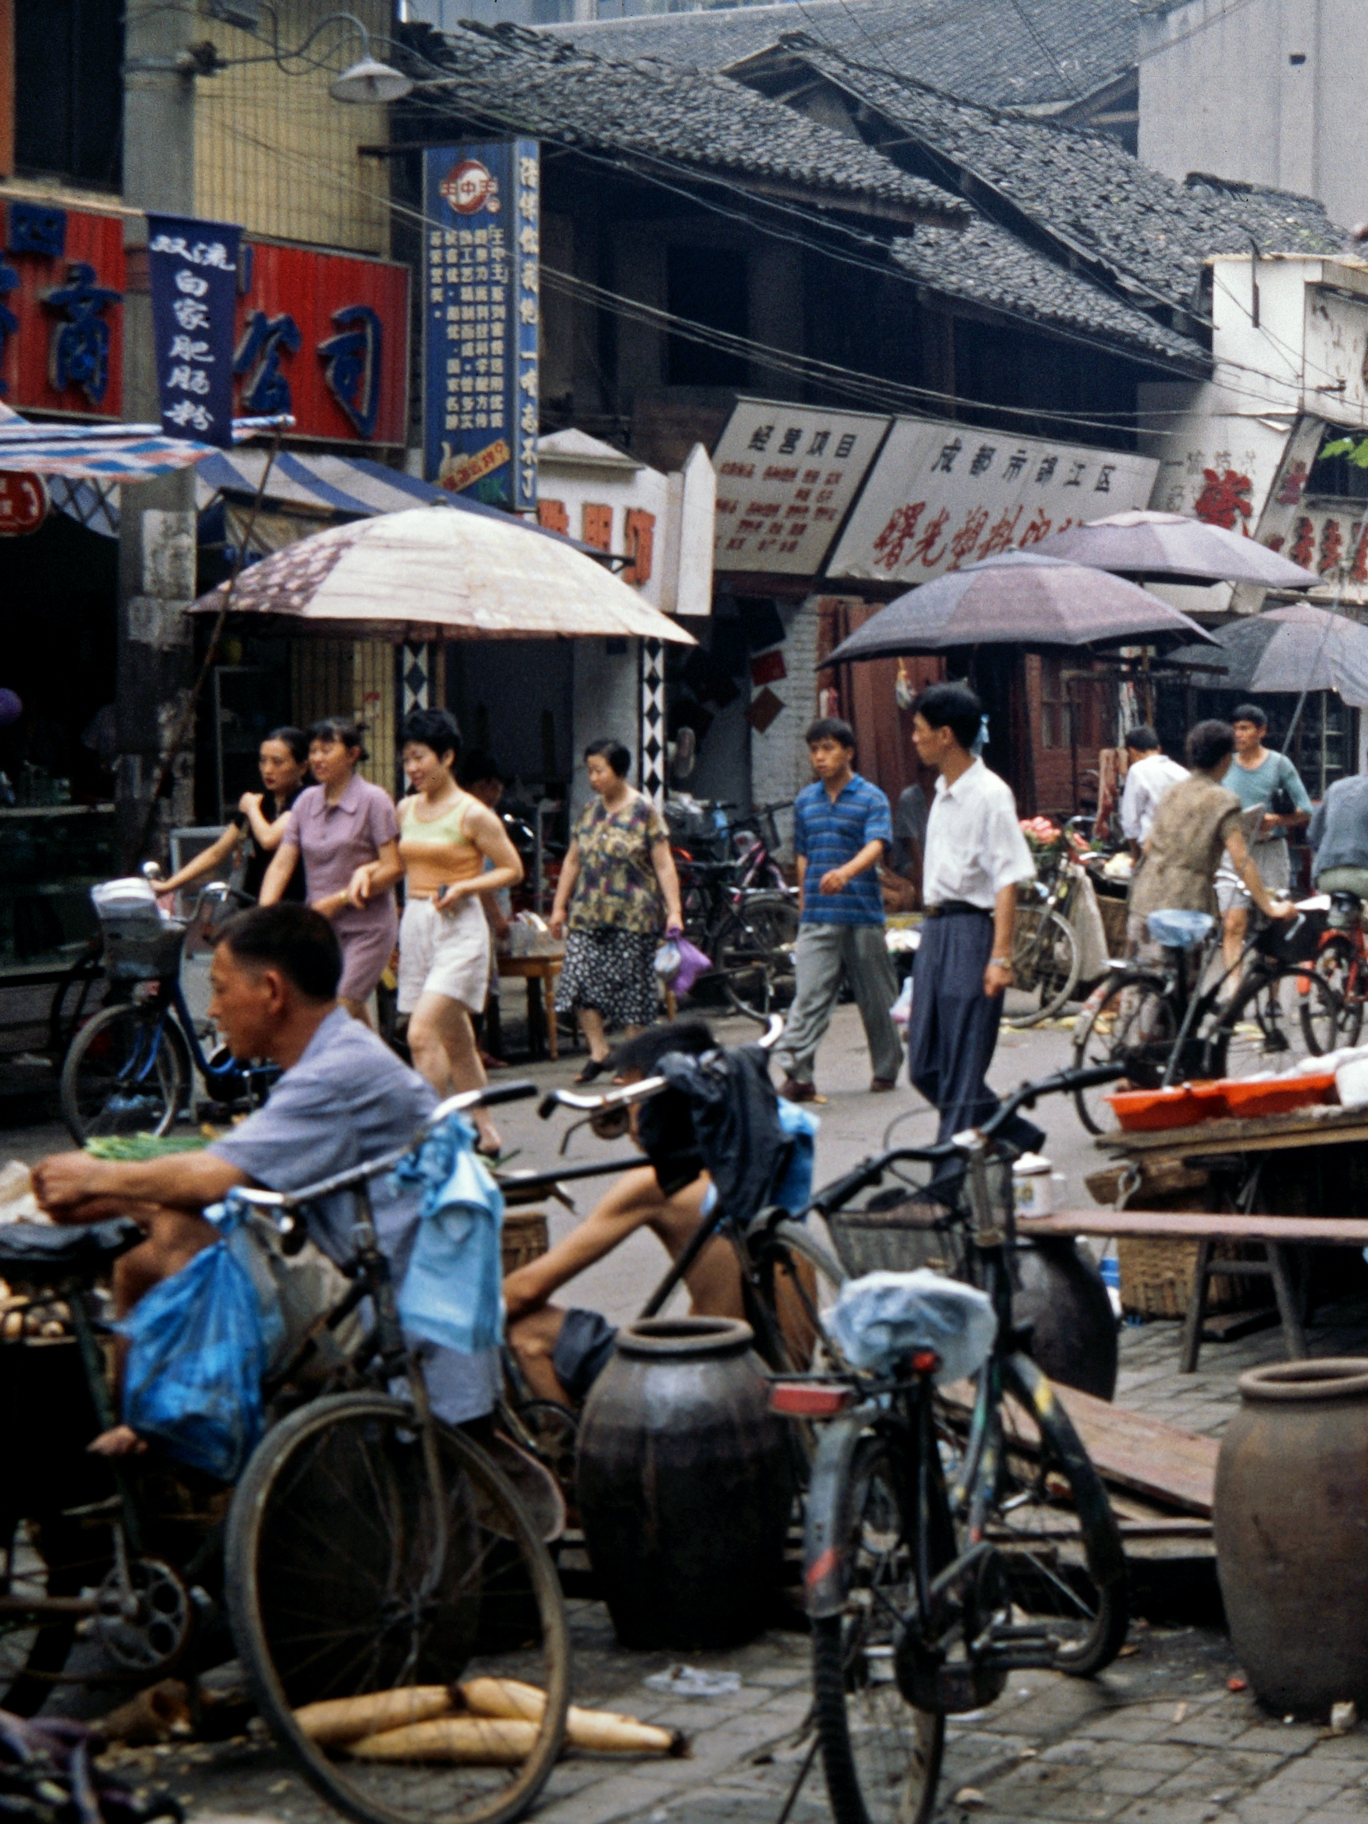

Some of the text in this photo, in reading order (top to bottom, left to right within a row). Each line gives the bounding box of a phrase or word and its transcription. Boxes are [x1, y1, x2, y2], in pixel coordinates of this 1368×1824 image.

[149, 234, 236, 271] 双流
[163, 269, 216, 431] 白家肥肠粉
[747, 424, 857, 458] 经营项目
[930, 437, 1116, 495] 成都市锦江区
